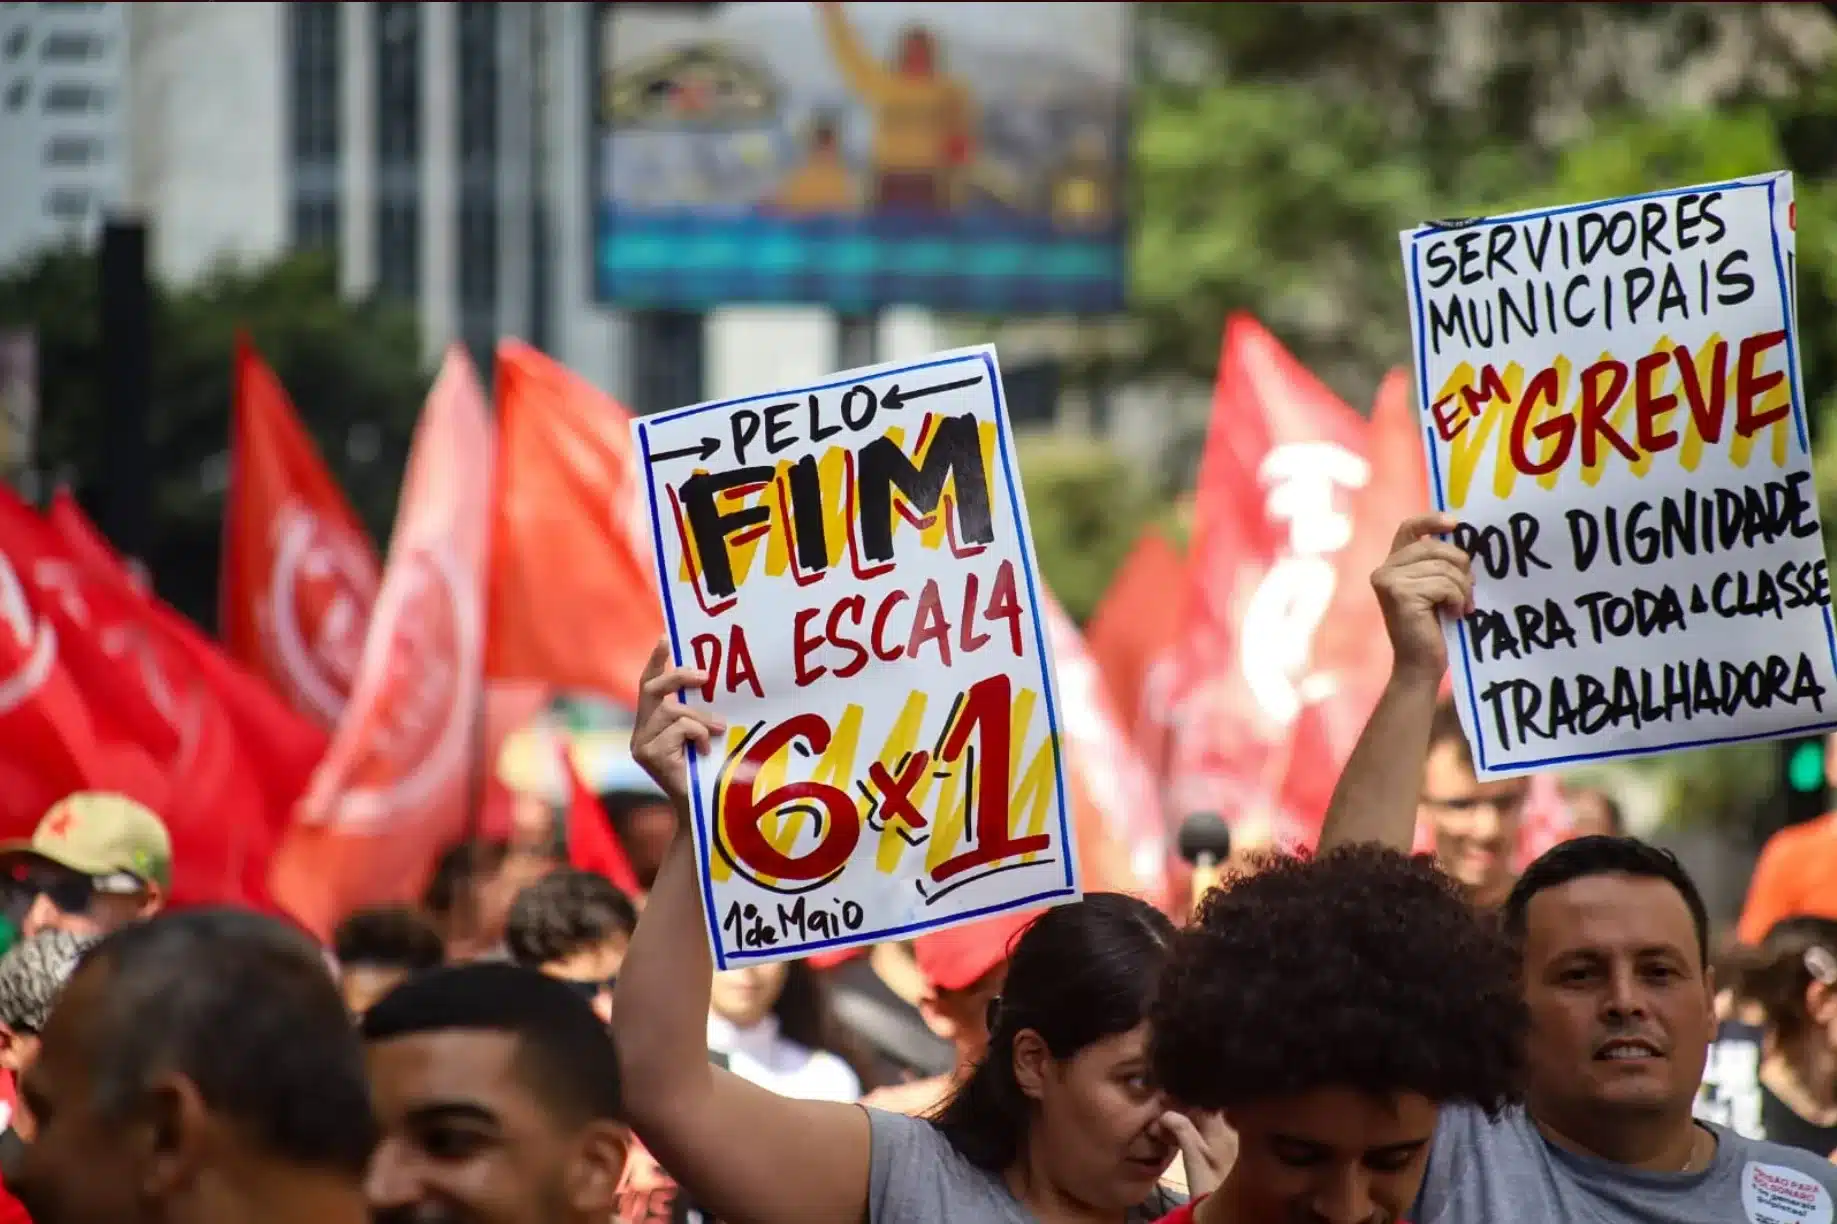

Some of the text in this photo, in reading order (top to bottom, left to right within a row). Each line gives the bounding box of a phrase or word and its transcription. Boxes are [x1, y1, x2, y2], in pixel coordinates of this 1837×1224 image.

[1426, 191, 1727, 288] SERVIDORES
[1429, 249, 1756, 354] MUNICIPAIS
[731, 384, 878, 464] PELO
[1431, 329, 1791, 475] EM GREVE
[676, 412, 994, 602] FIM
[1453, 471, 1820, 580] POR DIGNIDADE
[691, 559, 1024, 703] DA ESCALA
[1465, 598, 1577, 662] PARA
[1575, 584, 1686, 643] TODA
[1711, 558, 1831, 620] CLASSE
[1480, 652, 1826, 751] TRABALHADORA
[777, 895, 864, 941] Maio
